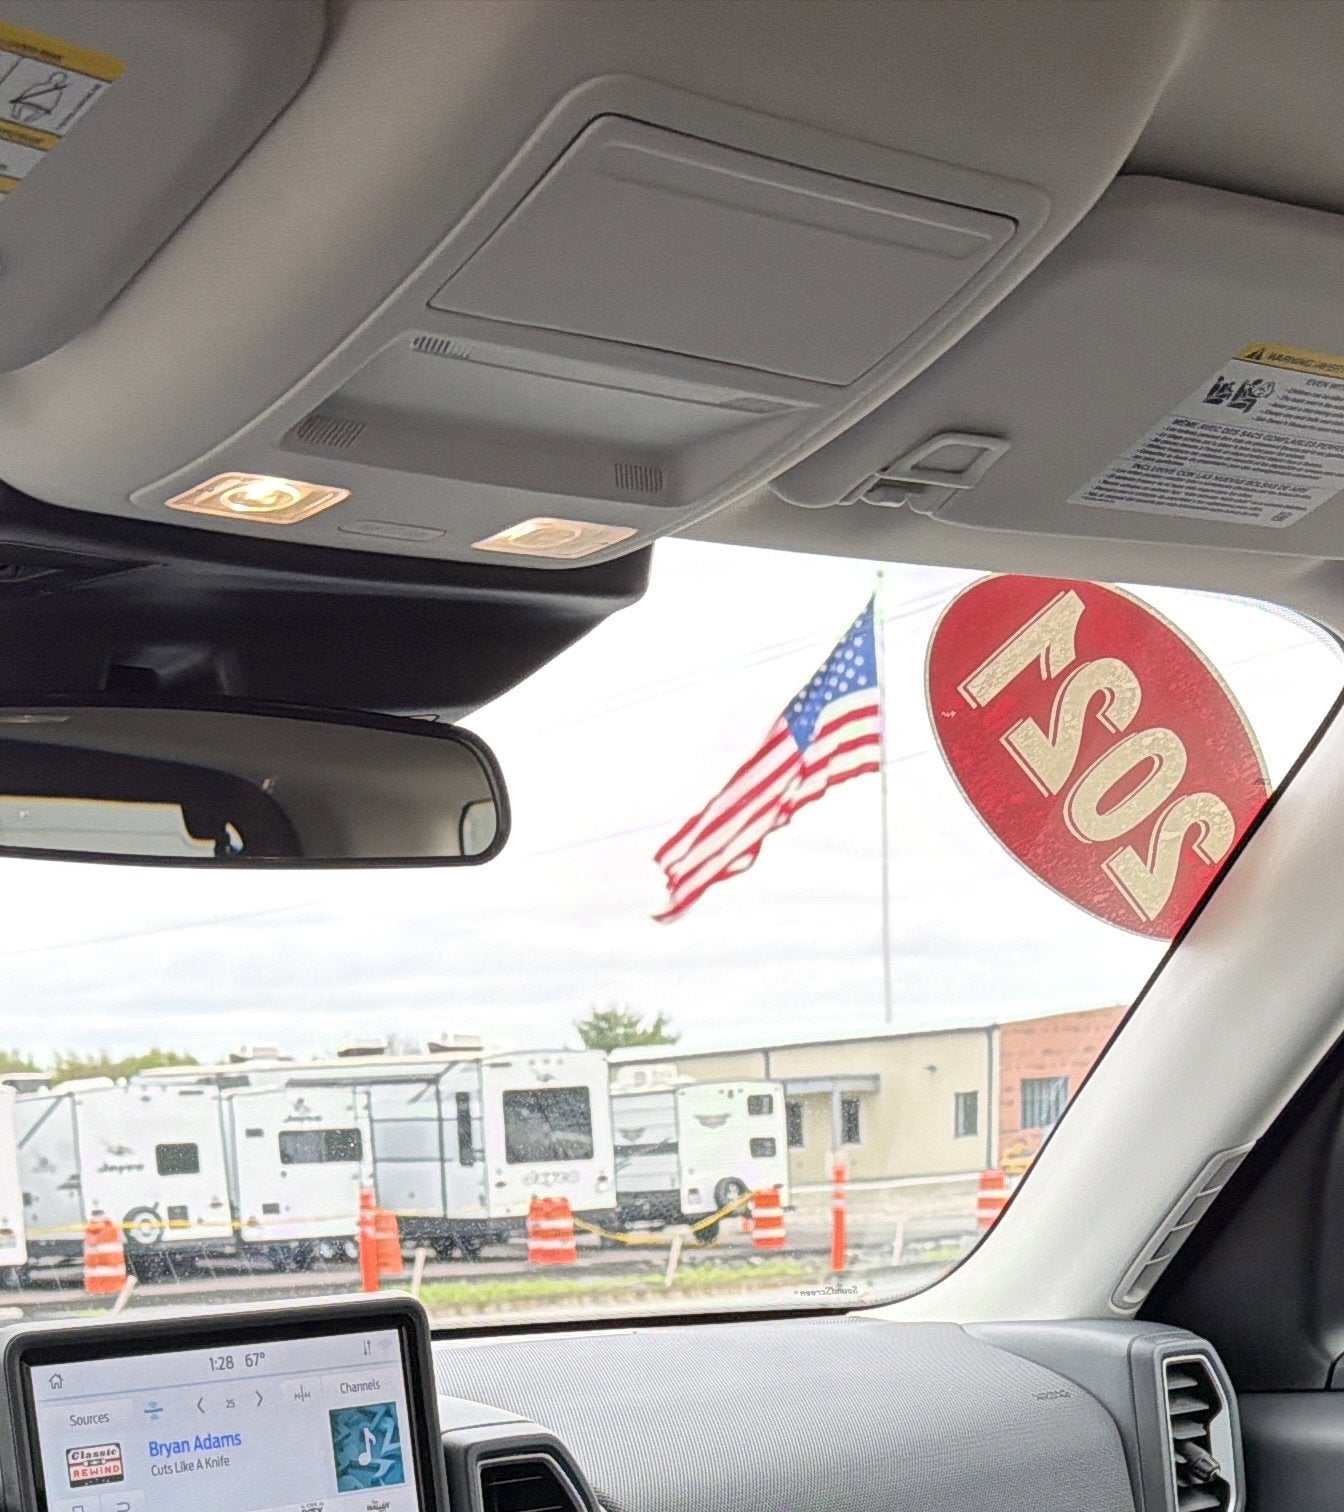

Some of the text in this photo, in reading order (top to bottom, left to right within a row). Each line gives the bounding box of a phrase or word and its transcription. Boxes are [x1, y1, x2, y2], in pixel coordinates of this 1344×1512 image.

[208, 1355, 235, 1371] 1:28
[340, 1379, 381, 1394] Channels
[225, 1399, 236, 1409] 25
[69, 1412, 110, 1427] Sources
[149, 1432, 243, 1459] Bryan Adams
[71, 1447, 117, 1461] Classic
[73, 1465, 120, 1479] REWIND
[151, 1463, 173, 1477] Cuts
[174, 1460, 195, 1473] Like
[205, 1455, 230, 1468] Knife
